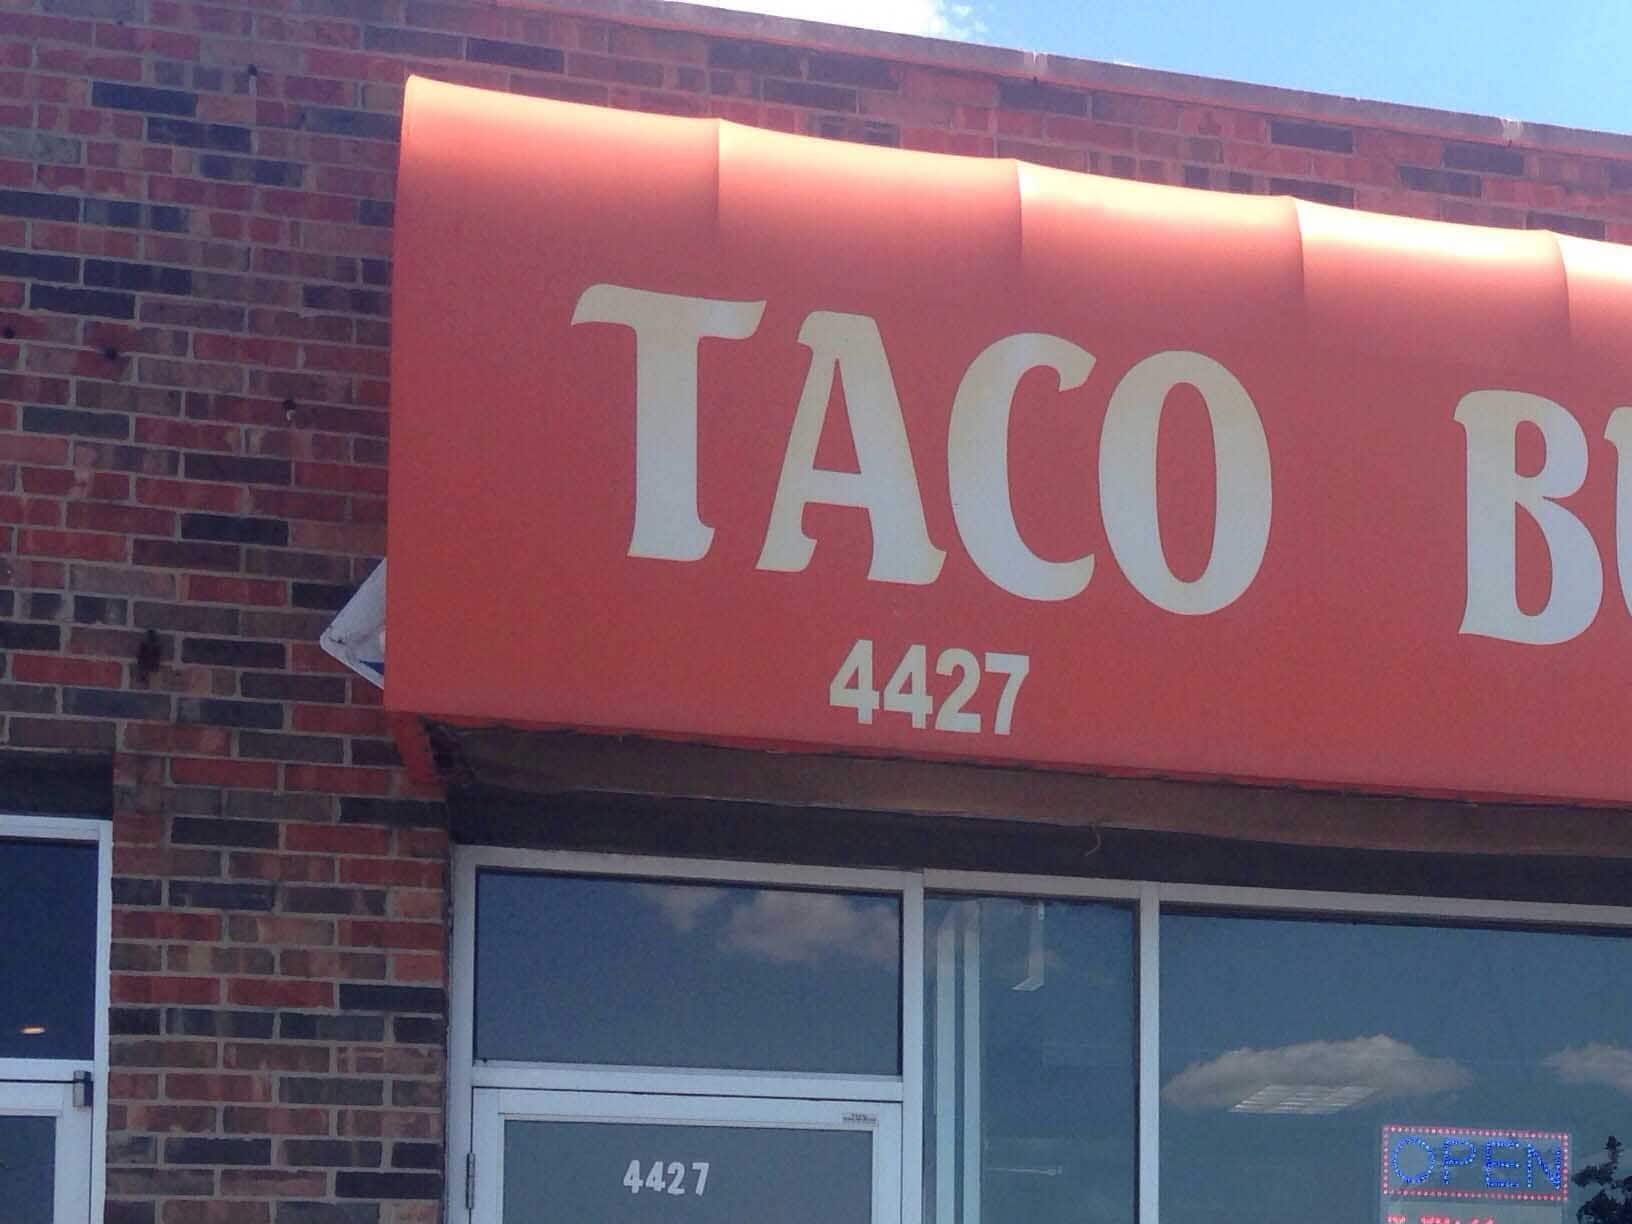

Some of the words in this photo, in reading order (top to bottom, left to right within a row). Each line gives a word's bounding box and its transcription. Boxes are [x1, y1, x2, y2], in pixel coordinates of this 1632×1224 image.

[571, 283, 1272, 615] TACO
[829, 639, 1030, 735] 4427
[623, 1159, 710, 1197] 4427
[1390, 1135, 1561, 1191] OPEN
